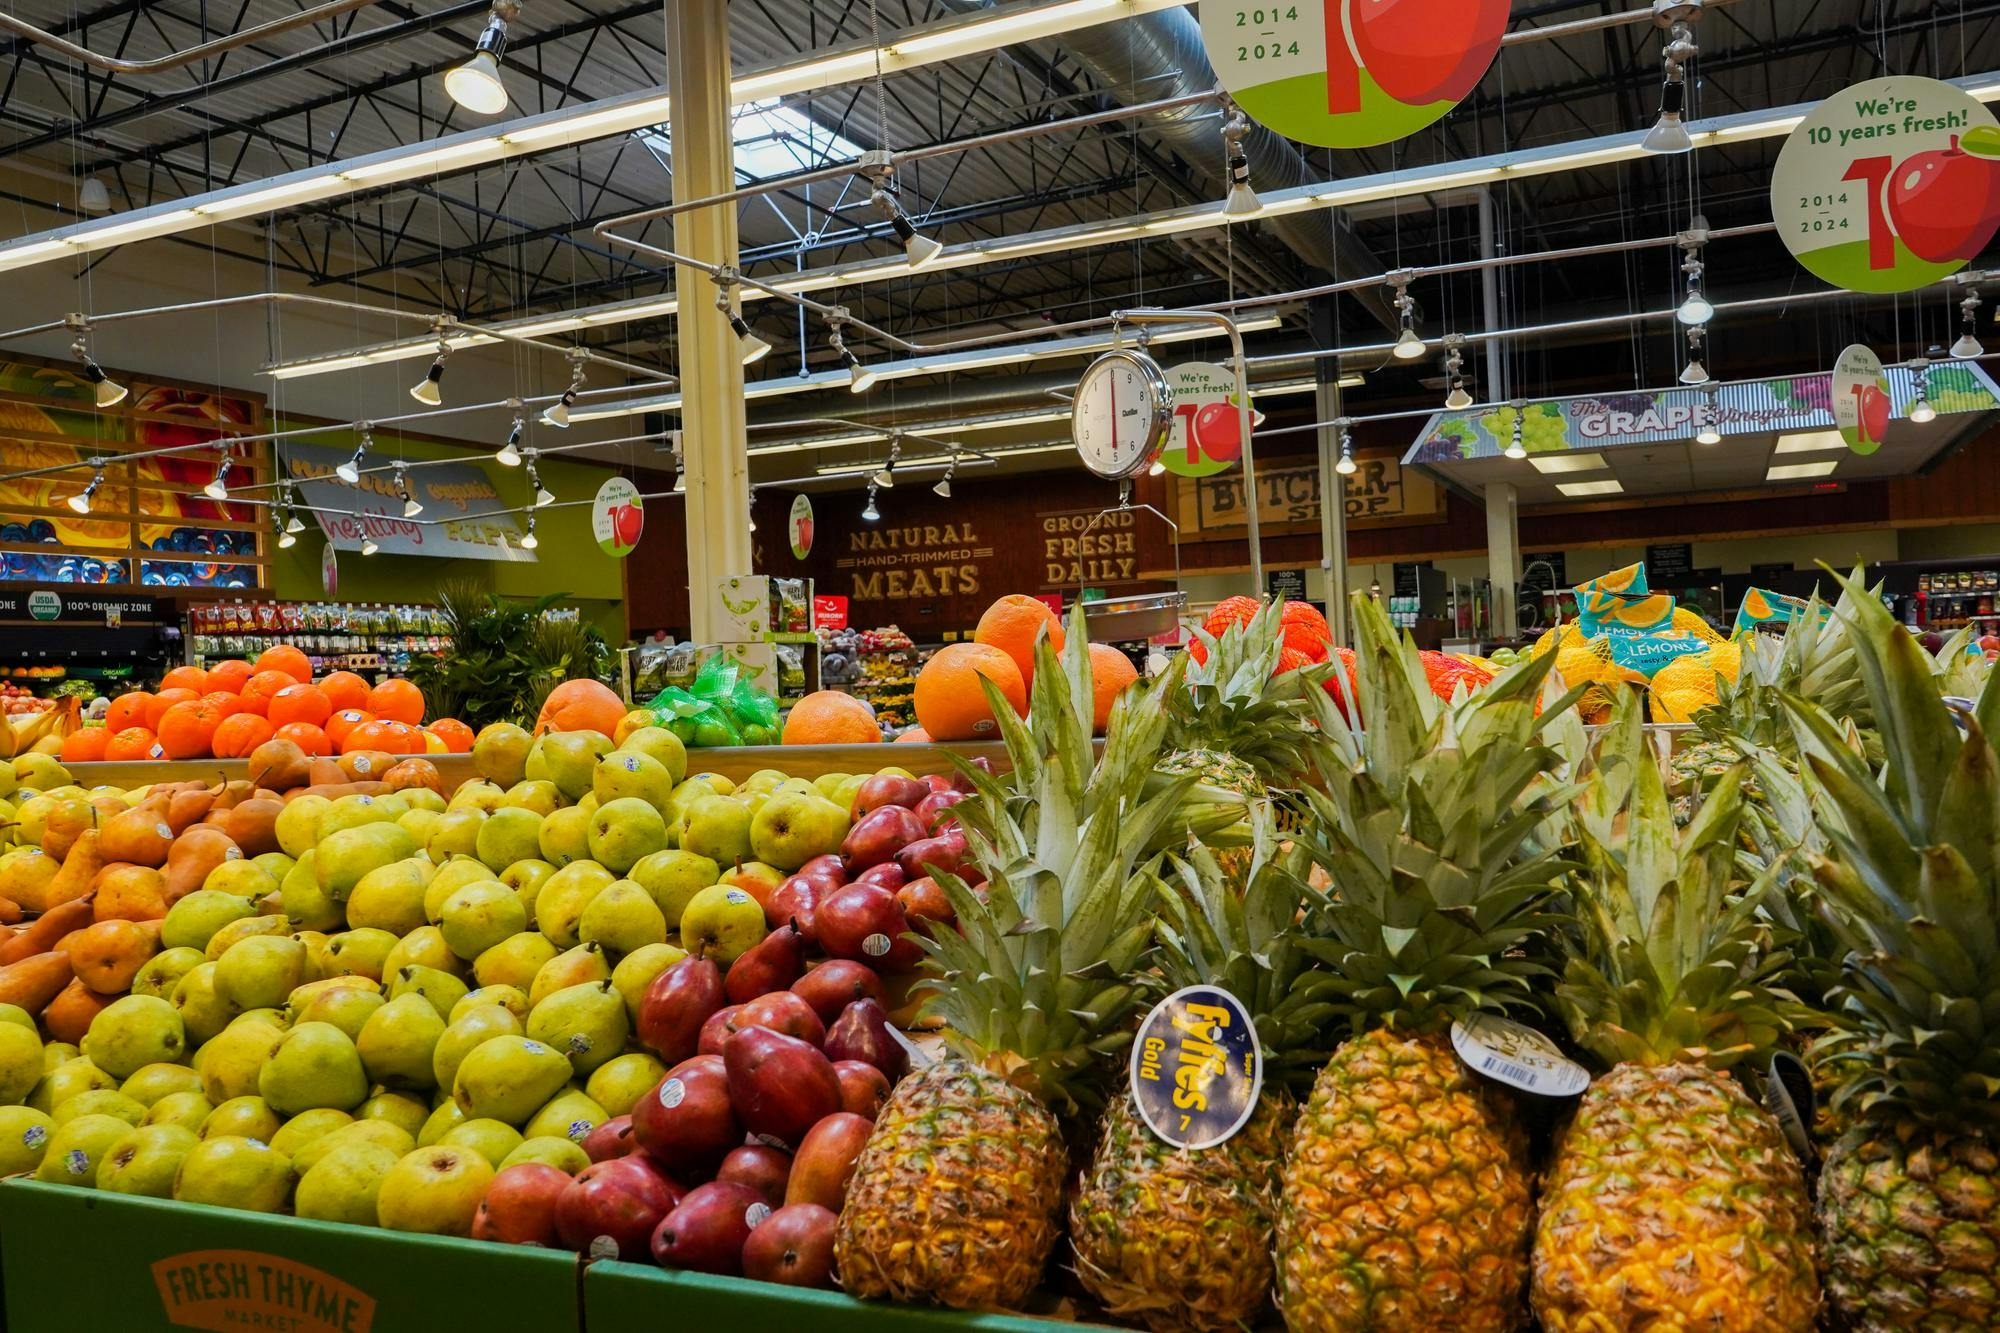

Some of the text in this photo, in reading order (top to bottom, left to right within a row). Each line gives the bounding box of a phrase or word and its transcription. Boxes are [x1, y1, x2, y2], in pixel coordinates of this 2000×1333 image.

[1236, 6, 1298, 27] 2014
[1237, 41, 1300, 61] 2024
[1855, 97, 1917, 118] We're
[1808, 109, 1968, 146] 10 years fresh!
[1800, 193, 1848, 208] 2014
[1801, 218, 1849, 233] 2024
[1111, 369, 1115, 381] 0
[1128, 373, 1132, 384] 9
[1180, 373, 1210, 383] We're
[1094, 382, 1097, 392] 1
[1172, 382, 1234, 397] years fresh!
[1139, 391, 1144, 402] 8
[1084, 404, 1089, 414] 2
[1570, 400, 1610, 418] The
[1141, 418, 1146, 428] 7
[1085, 430, 1090, 440] 3
[1096, 447, 1101, 457] 4
[1130, 440, 1135, 451] 6
[1113, 451, 1118, 463] 5
[1043, 512, 1134, 533] GROUND
[850, 523, 978, 551] NATURAL
[1045, 533, 1134, 558] FRESH
[856, 549, 971, 566] HAND-TRIMMED
[1047, 558, 1134, 584] DAILY
[851, 565, 980, 600] MEATS
[35, 596, 54, 604] USDA
[67, 602, 152, 612] 100% ORGANIC ZONE
[32, 606, 57, 614] ORGANIC
[1140, 1037, 1165, 1081] Gold
[1171, 1003, 1231, 1112] Fyffes
[1179, 1115, 1191, 1131] 7
[166, 1262, 360, 1333] FRESH THYME
[224, 1309, 299, 1330] MARKET
